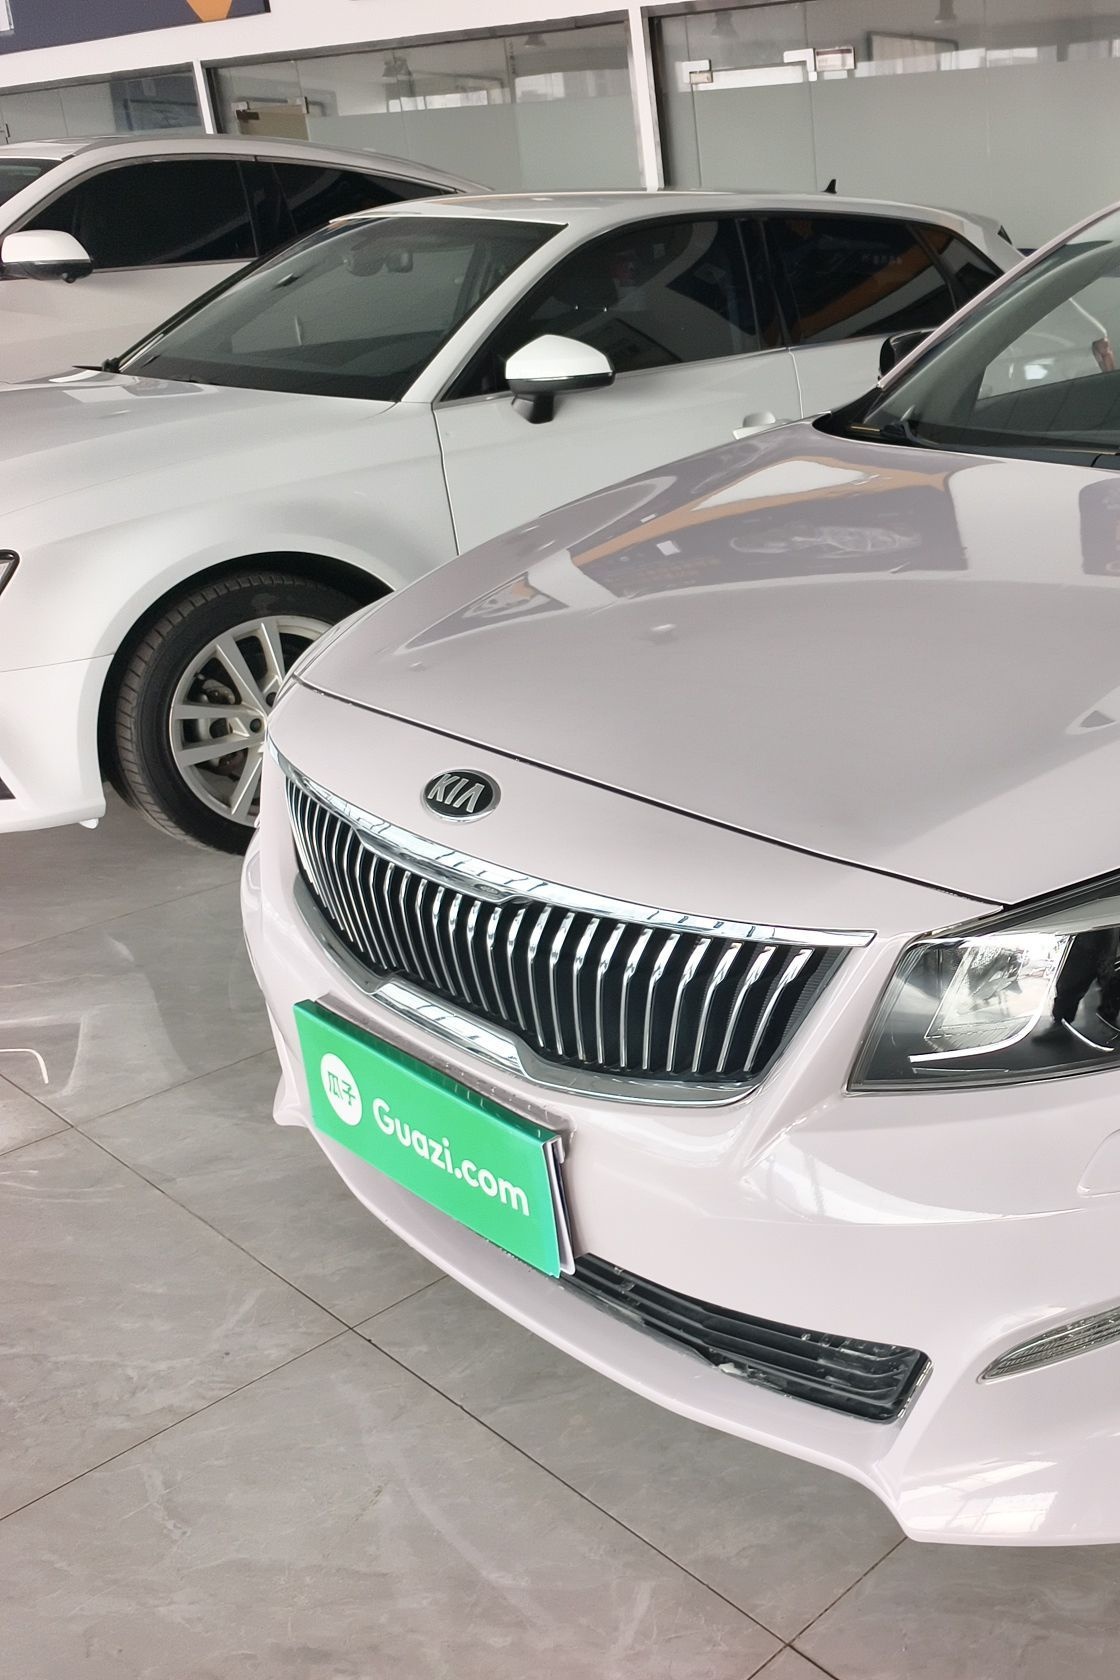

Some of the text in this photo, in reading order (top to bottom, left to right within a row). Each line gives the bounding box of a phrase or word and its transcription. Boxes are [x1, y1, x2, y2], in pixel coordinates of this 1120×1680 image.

[427, 773, 485, 813] KIA
[327, 1071, 356, 1106] 瓜子
[372, 1097, 530, 1217] Guazi.com
